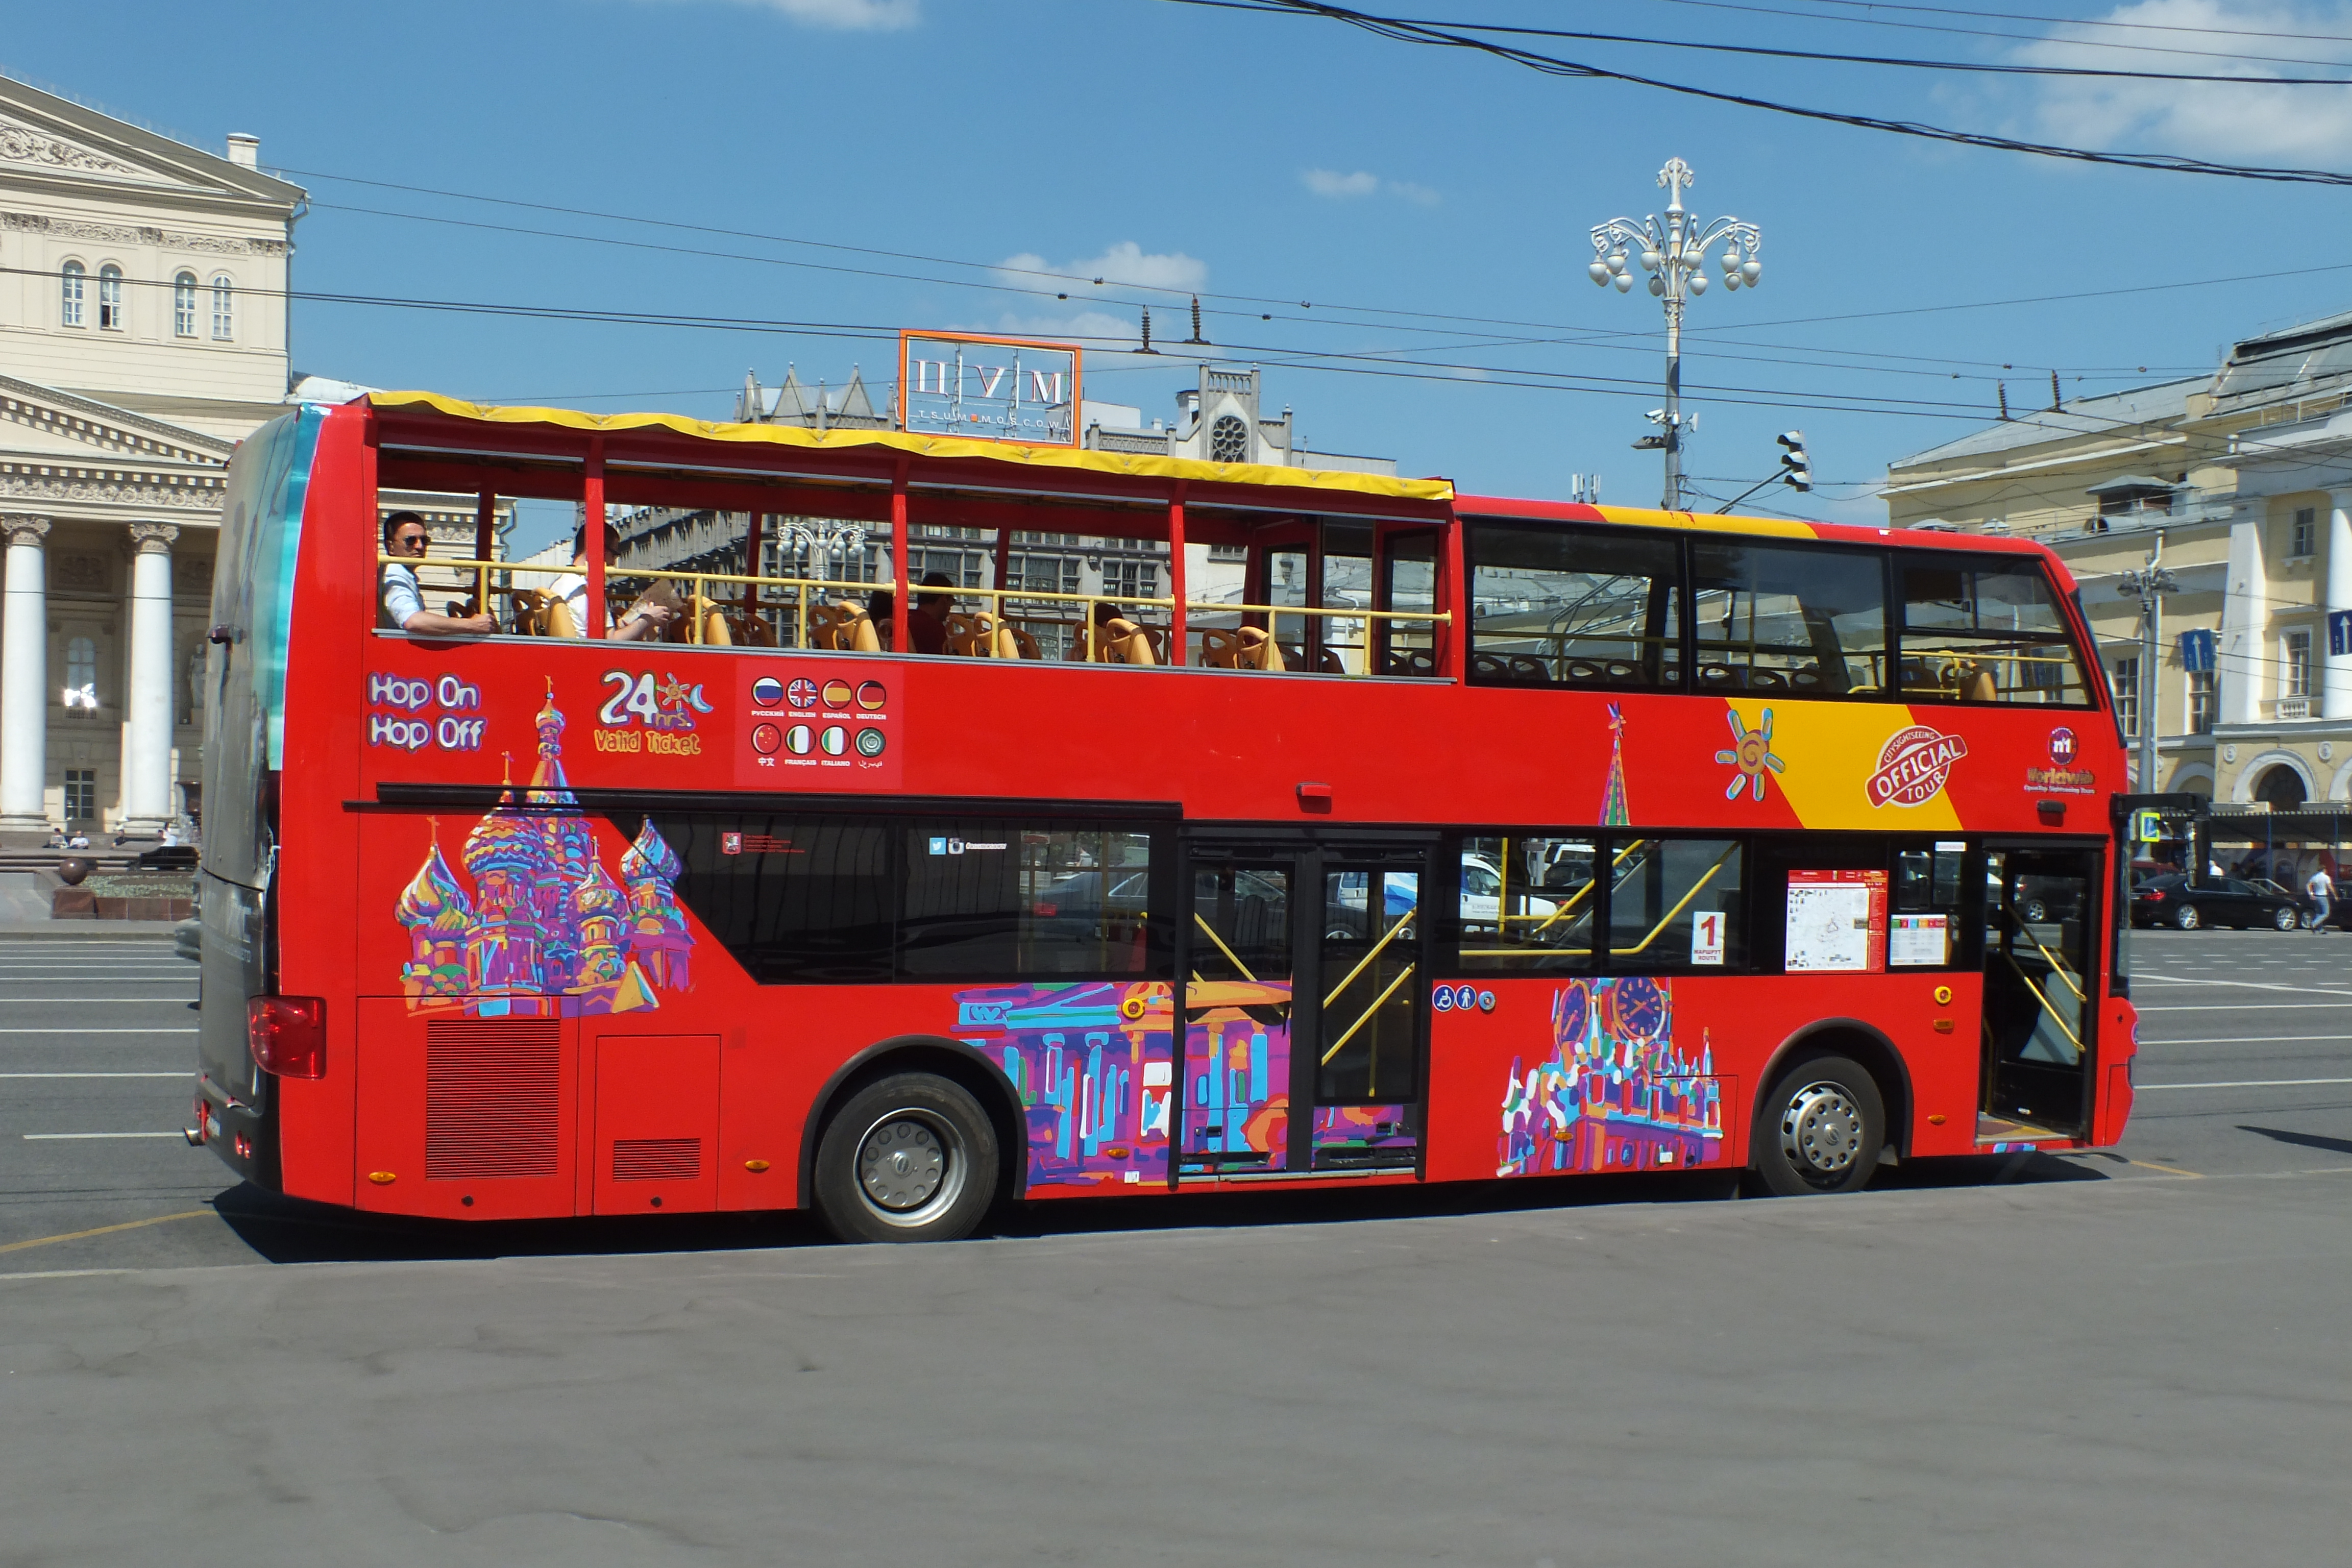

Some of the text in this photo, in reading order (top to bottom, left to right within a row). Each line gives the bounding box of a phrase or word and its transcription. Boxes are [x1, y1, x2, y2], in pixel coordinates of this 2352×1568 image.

[914, 359, 1063, 404] ЦУМ
[918, 409, 1060, 429] TSUM MOSCOW
[371, 675, 478, 709] Hop On
[600, 671, 659, 724] 24
[371, 717, 484, 750] Hop Off
[594, 729, 701, 755] Valid Ticket
[1876, 740, 1962, 797] OFFICIAL
[1906, 771, 1944, 801] TOUR
[1700, 915, 1716, 946] 1
